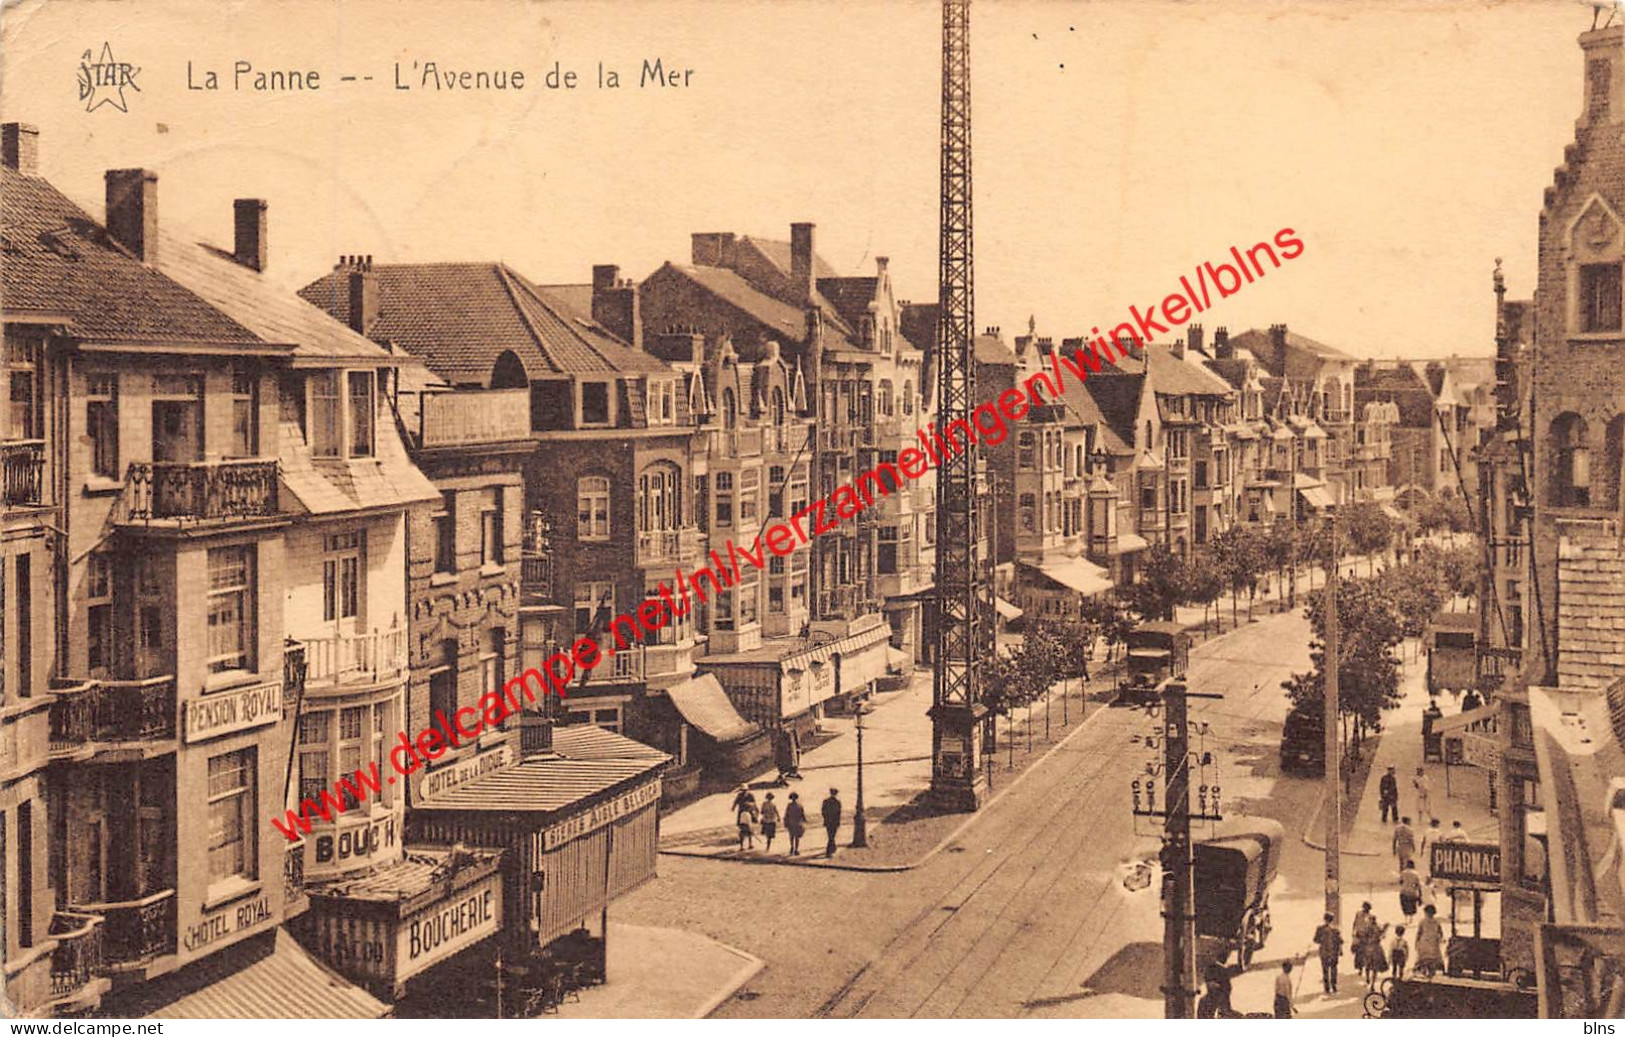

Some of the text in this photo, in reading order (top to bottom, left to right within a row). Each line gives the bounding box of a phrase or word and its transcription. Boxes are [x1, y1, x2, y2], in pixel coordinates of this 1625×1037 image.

[189, 688, 278, 734] PENSION ROYAL
[428, 767, 458, 796] HOTEL
[237, 896, 272, 930] ROYAL
[409, 888, 493, 960] BOUCHERIE
